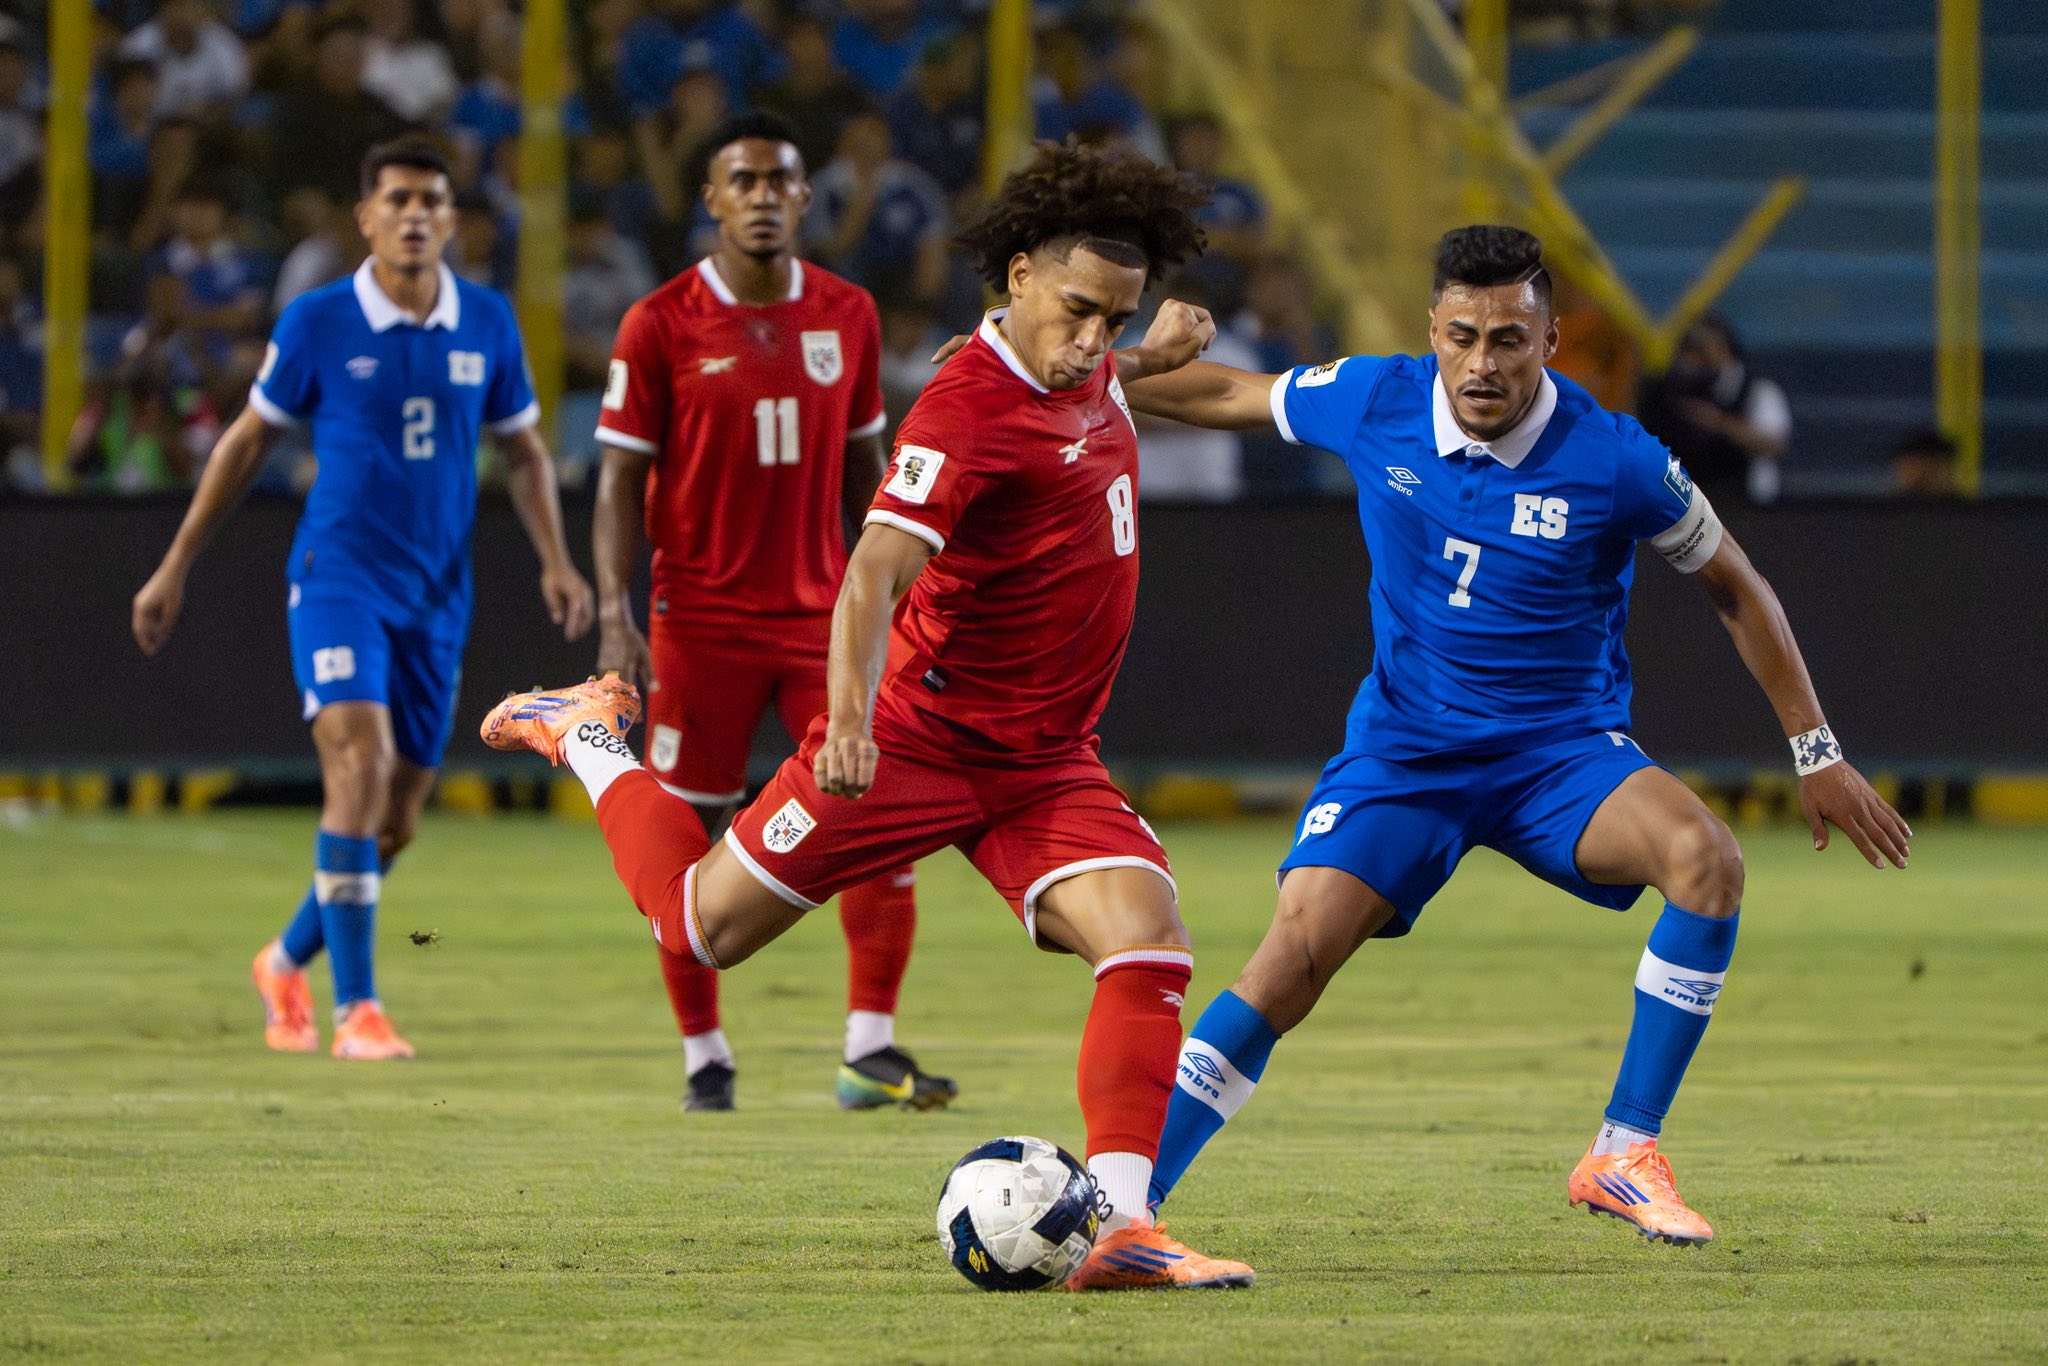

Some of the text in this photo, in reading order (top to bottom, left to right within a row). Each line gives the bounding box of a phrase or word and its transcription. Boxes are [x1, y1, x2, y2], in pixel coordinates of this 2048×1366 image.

[402, 396, 436, 460] 2
[753, 396, 799, 466] 11
[1106, 473, 1136, 557] 8
[1387, 478, 1413, 496] umbro
[1510, 493, 1569, 540] ES
[1443, 537, 1482, 608] 7
